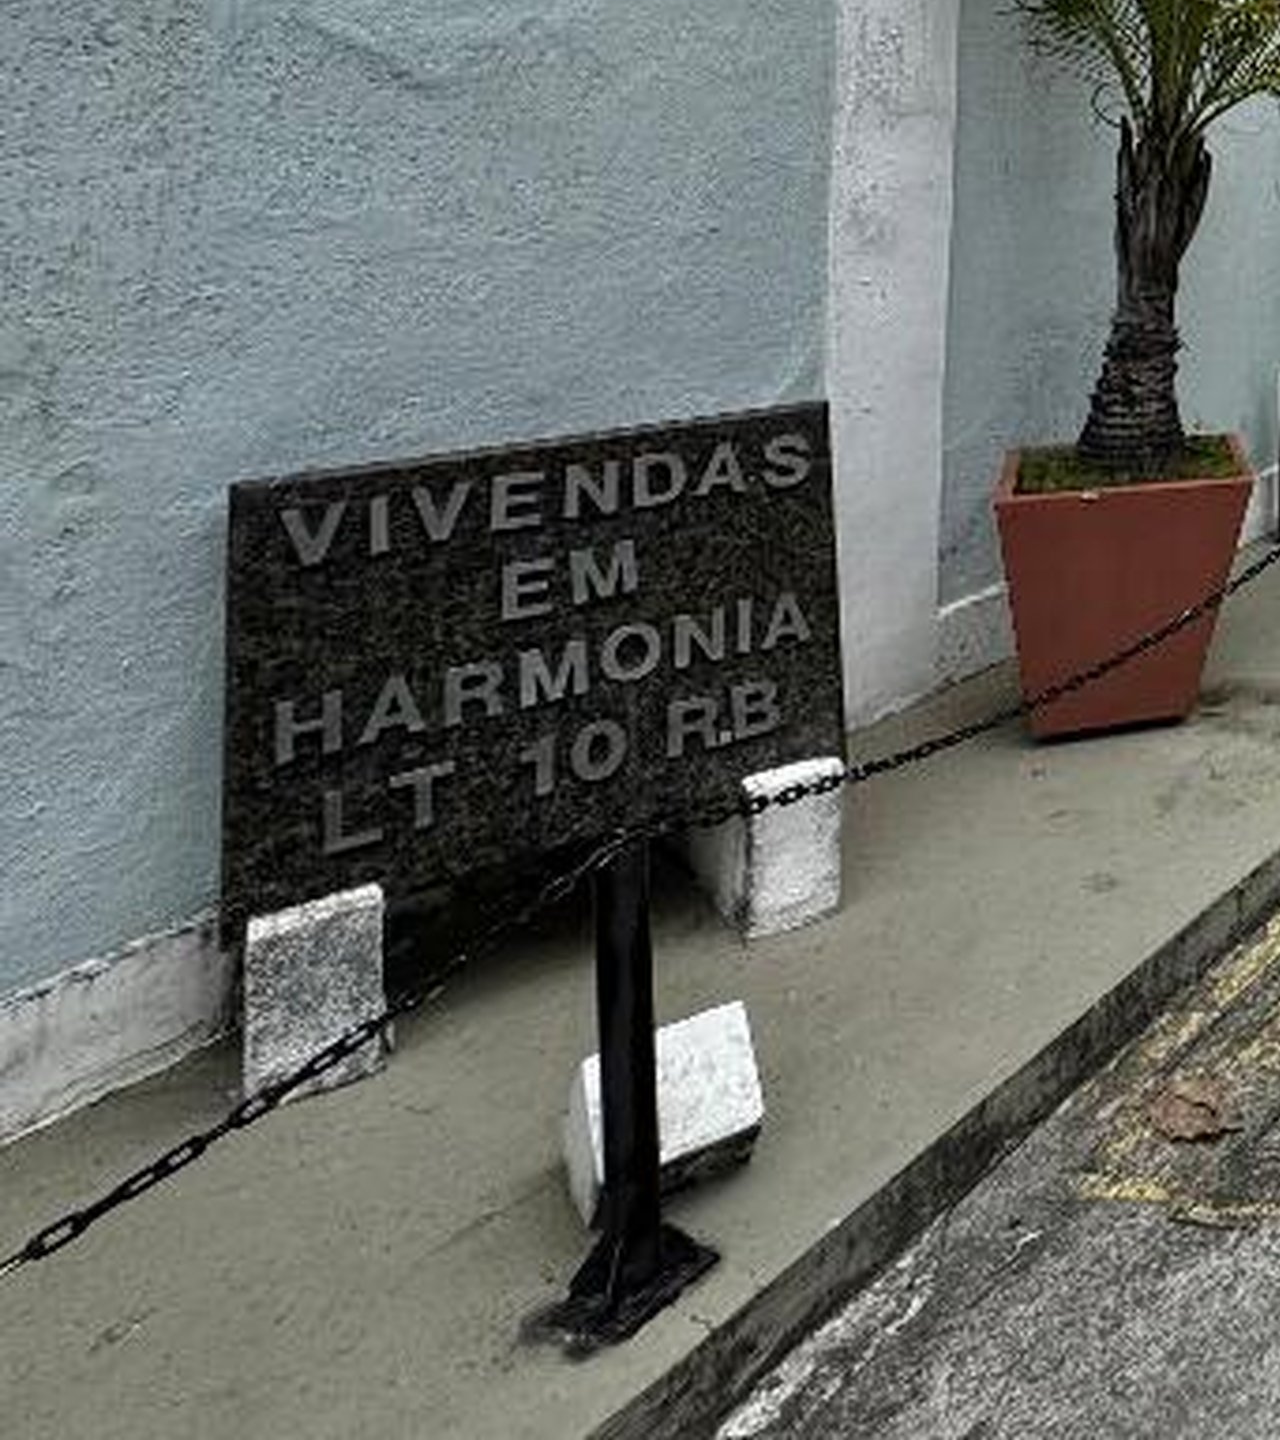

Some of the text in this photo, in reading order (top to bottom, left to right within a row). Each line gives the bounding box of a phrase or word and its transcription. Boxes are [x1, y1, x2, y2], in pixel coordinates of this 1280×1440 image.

[280, 433, 810, 567] VIVENDAS
[501, 539, 640, 621] EM
[273, 591, 811, 764] HARMONIA
[322, 760, 456, 855] LT
[520, 718, 629, 797] 10
